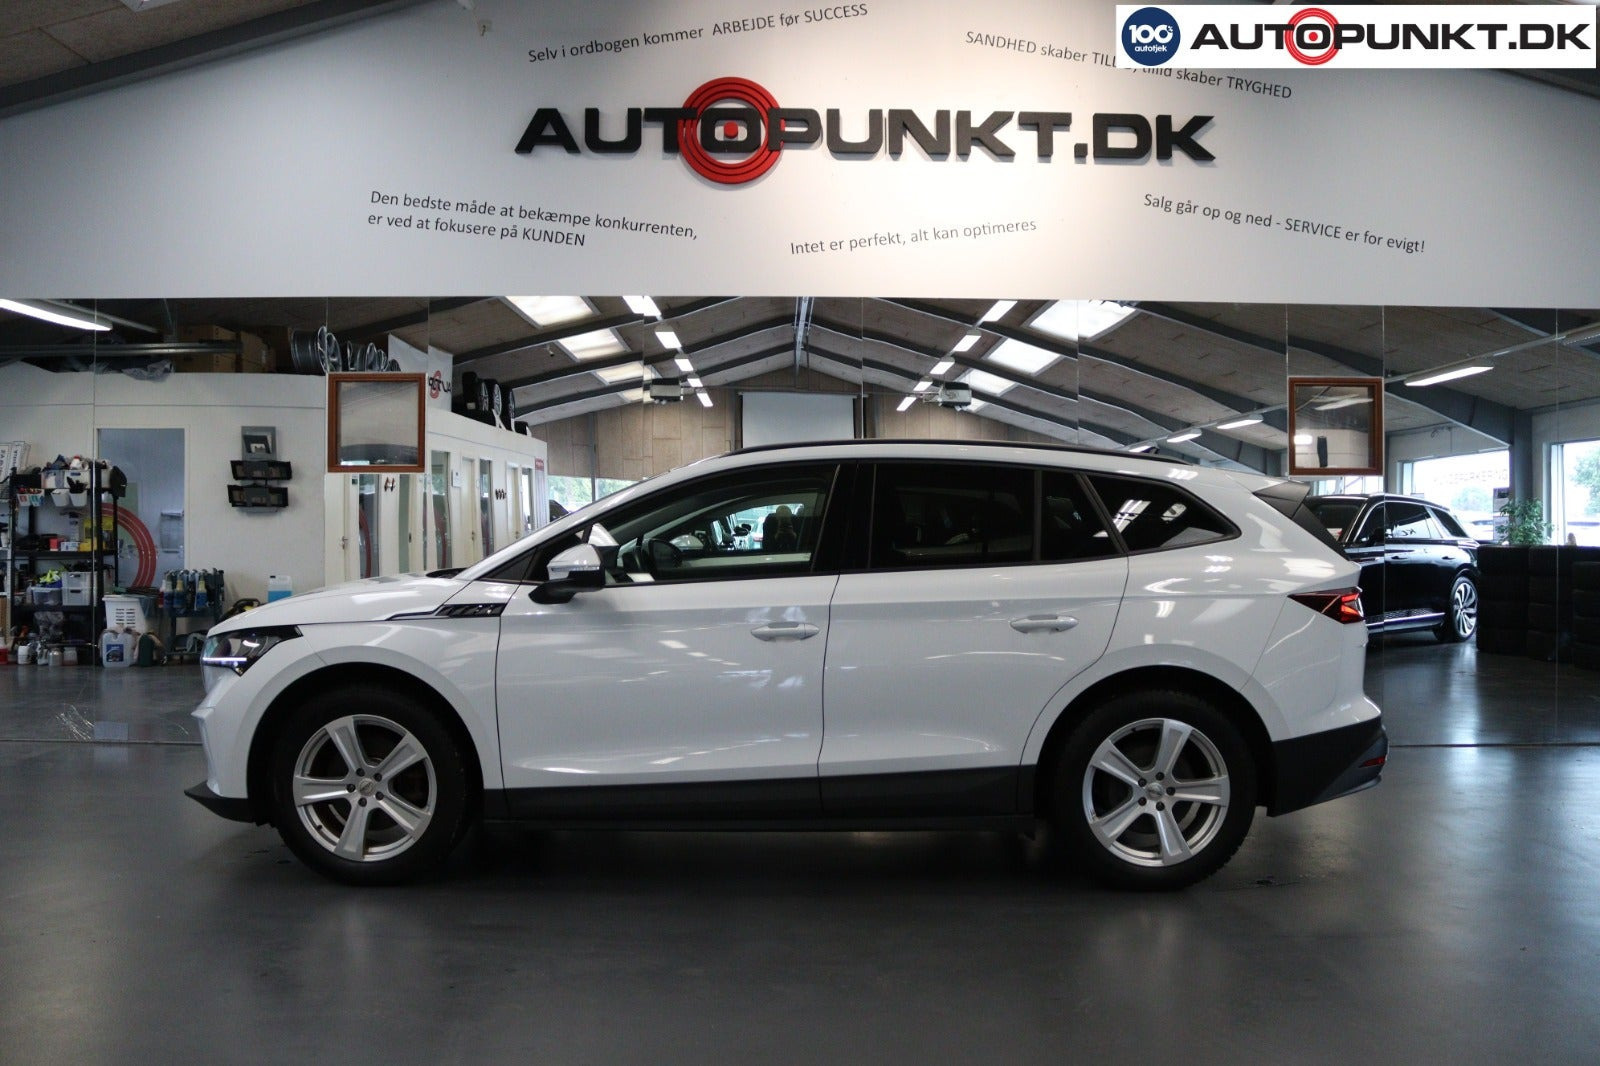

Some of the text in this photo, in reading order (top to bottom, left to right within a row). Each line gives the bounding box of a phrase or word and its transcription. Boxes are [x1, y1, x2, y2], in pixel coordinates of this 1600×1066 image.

[528, 3, 868, 62] Selv i ordbogen kommer ARBEJDE før SUCCESS
[966, 31, 1036, 54] SANDHED
[1041, 44, 1087, 63] skaber
[1092, 52, 1136, 73] TILL,
[1176, 67, 1222, 87] skaber
[1227, 75, 1292, 99] TRYGHED
[515, 107, 1216, 161] AUTOPUNKT.DK
[368, 215, 585, 246] er ved at fokusere på KUNDEN
[371, 190, 698, 240] Den bedste måde at bekæmpe konkurrenten,
[791, 220, 1037, 254] Intet er perfekt, alt kan optimeres
[1143, 193, 1173, 213] Salg
[1176, 199, 1199, 215] går
[1202, 206, 1221, 220] op
[1224, 209, 1242, 225] og
[1245, 213, 1273, 228] ned
[1284, 217, 1342, 240] SERVICE
[1345, 230, 1360, 242] er
[1363, 230, 1383, 246] for
[1386, 238, 1425, 254] evigt!
